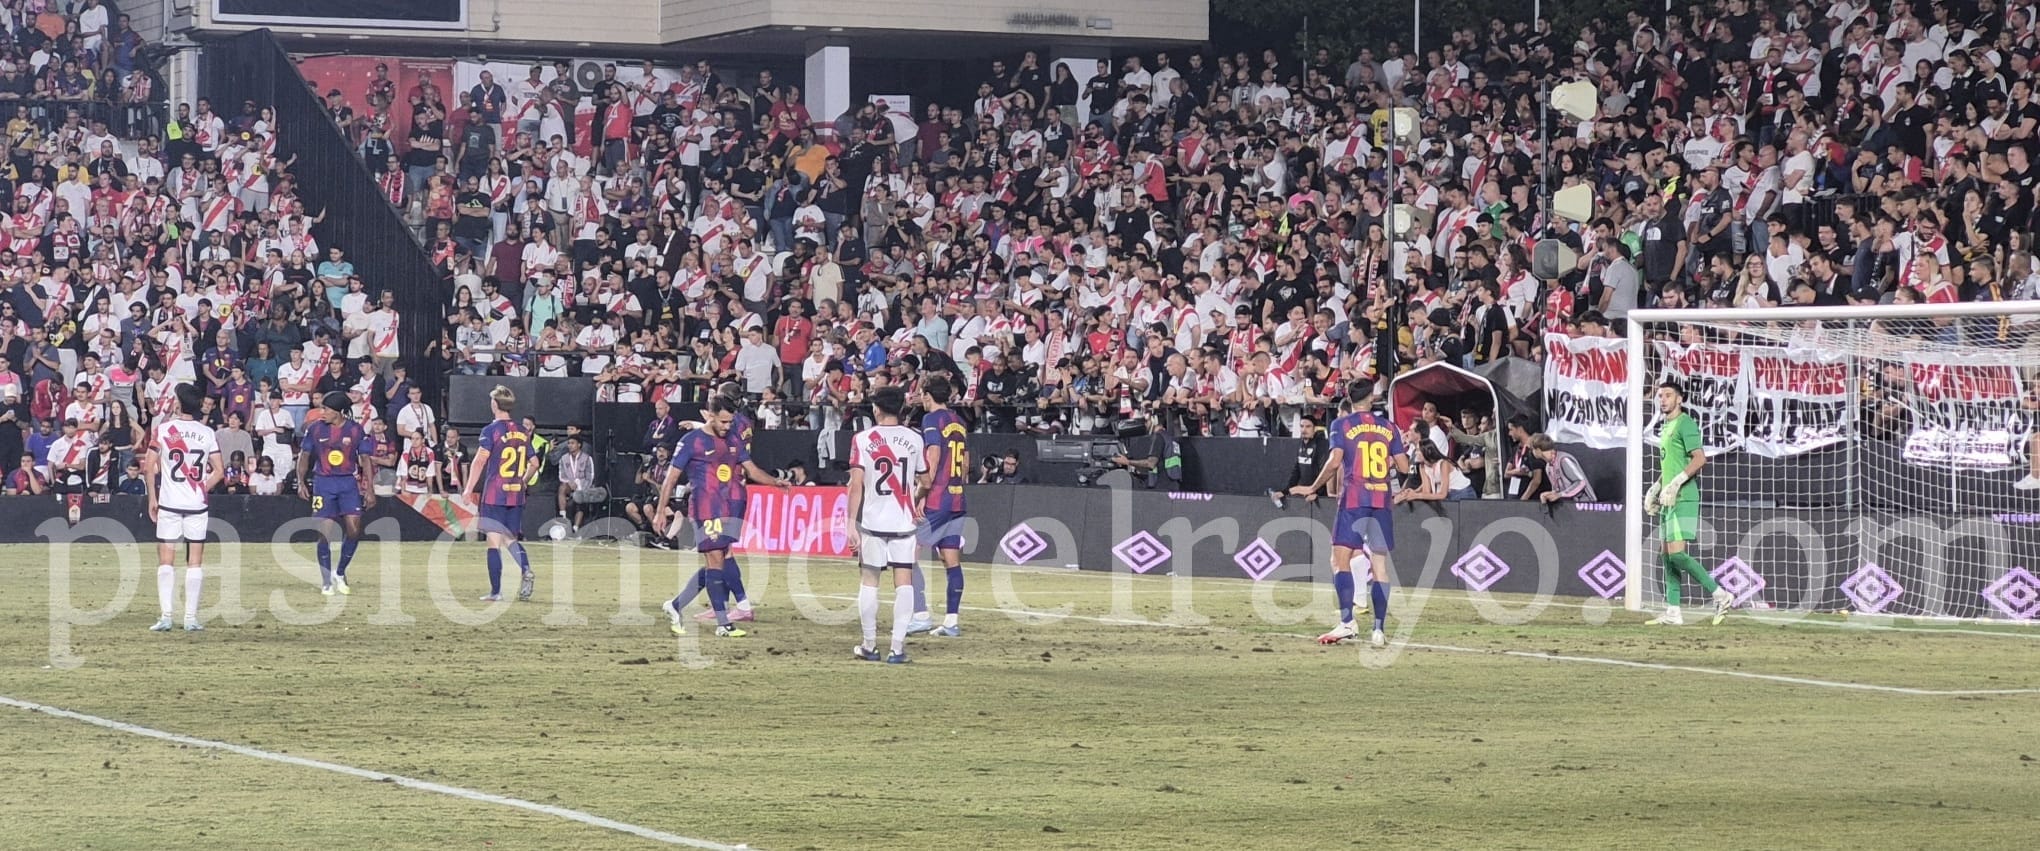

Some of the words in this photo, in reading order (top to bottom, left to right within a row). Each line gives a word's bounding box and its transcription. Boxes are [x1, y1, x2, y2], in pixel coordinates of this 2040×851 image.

[168, 448, 205, 483] 23
[500, 446, 526, 478] 21
[874, 457, 908, 496] 21
[948, 440, 965, 478] 15
[1357, 441, 1388, 479] 18
[311, 496, 323, 509] 23
[704, 518, 723, 535] 24
